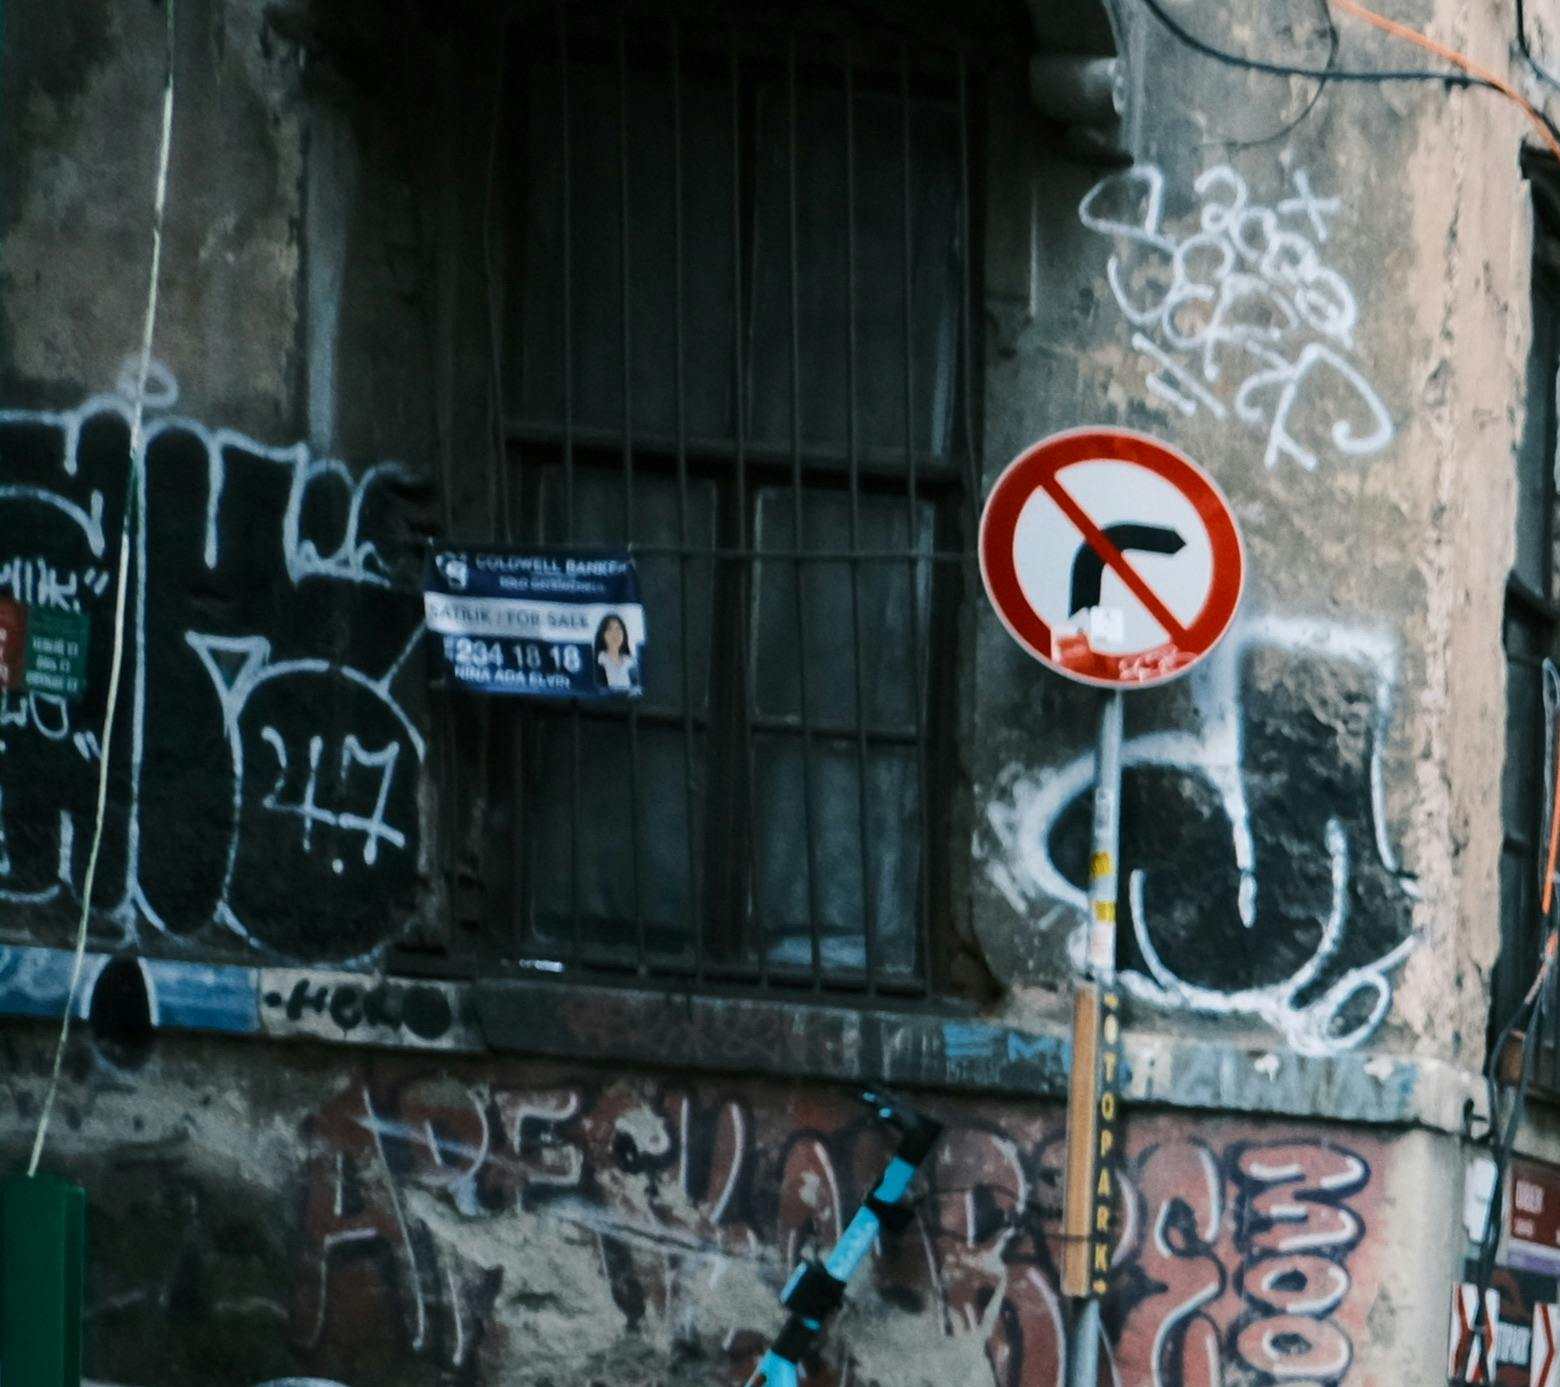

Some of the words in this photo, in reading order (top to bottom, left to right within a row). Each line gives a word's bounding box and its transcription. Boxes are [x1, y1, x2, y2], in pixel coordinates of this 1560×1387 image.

[475, 552, 560, 573] COLDWELL
[507, 608, 541, 627] FOR
[547, 609, 589, 629] SALE
[455, 637, 504, 667] 234
